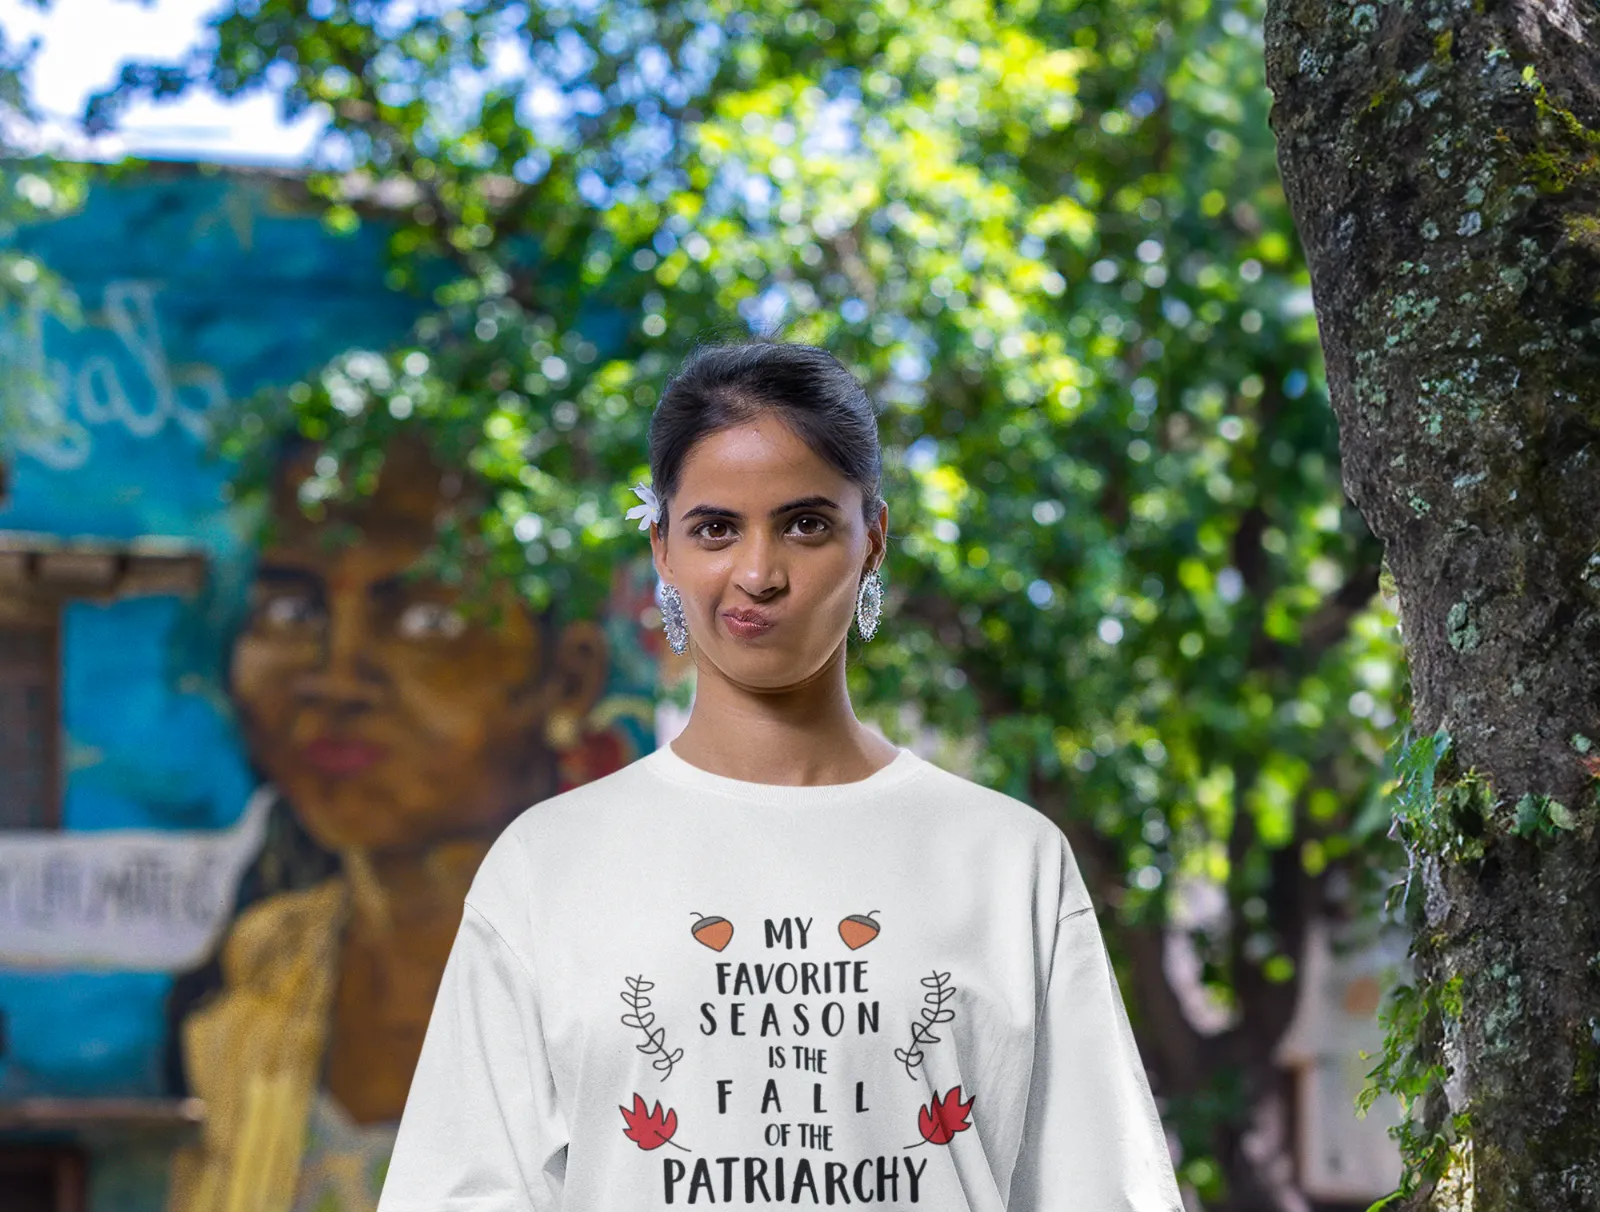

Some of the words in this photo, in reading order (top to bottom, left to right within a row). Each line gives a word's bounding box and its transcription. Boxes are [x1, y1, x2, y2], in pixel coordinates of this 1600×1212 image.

[764, 916, 813, 950] MY
[715, 960, 869, 996] FAVORITE
[699, 1001, 880, 1037] SEASON
[768, 1045, 786, 1069] IS
[792, 1045, 828, 1074] THE
[716, 1078, 870, 1114] FALL
[764, 1123, 791, 1147] OF
[797, 1123, 834, 1152] THE
[663, 1155, 928, 1206] PATRIARCHY
